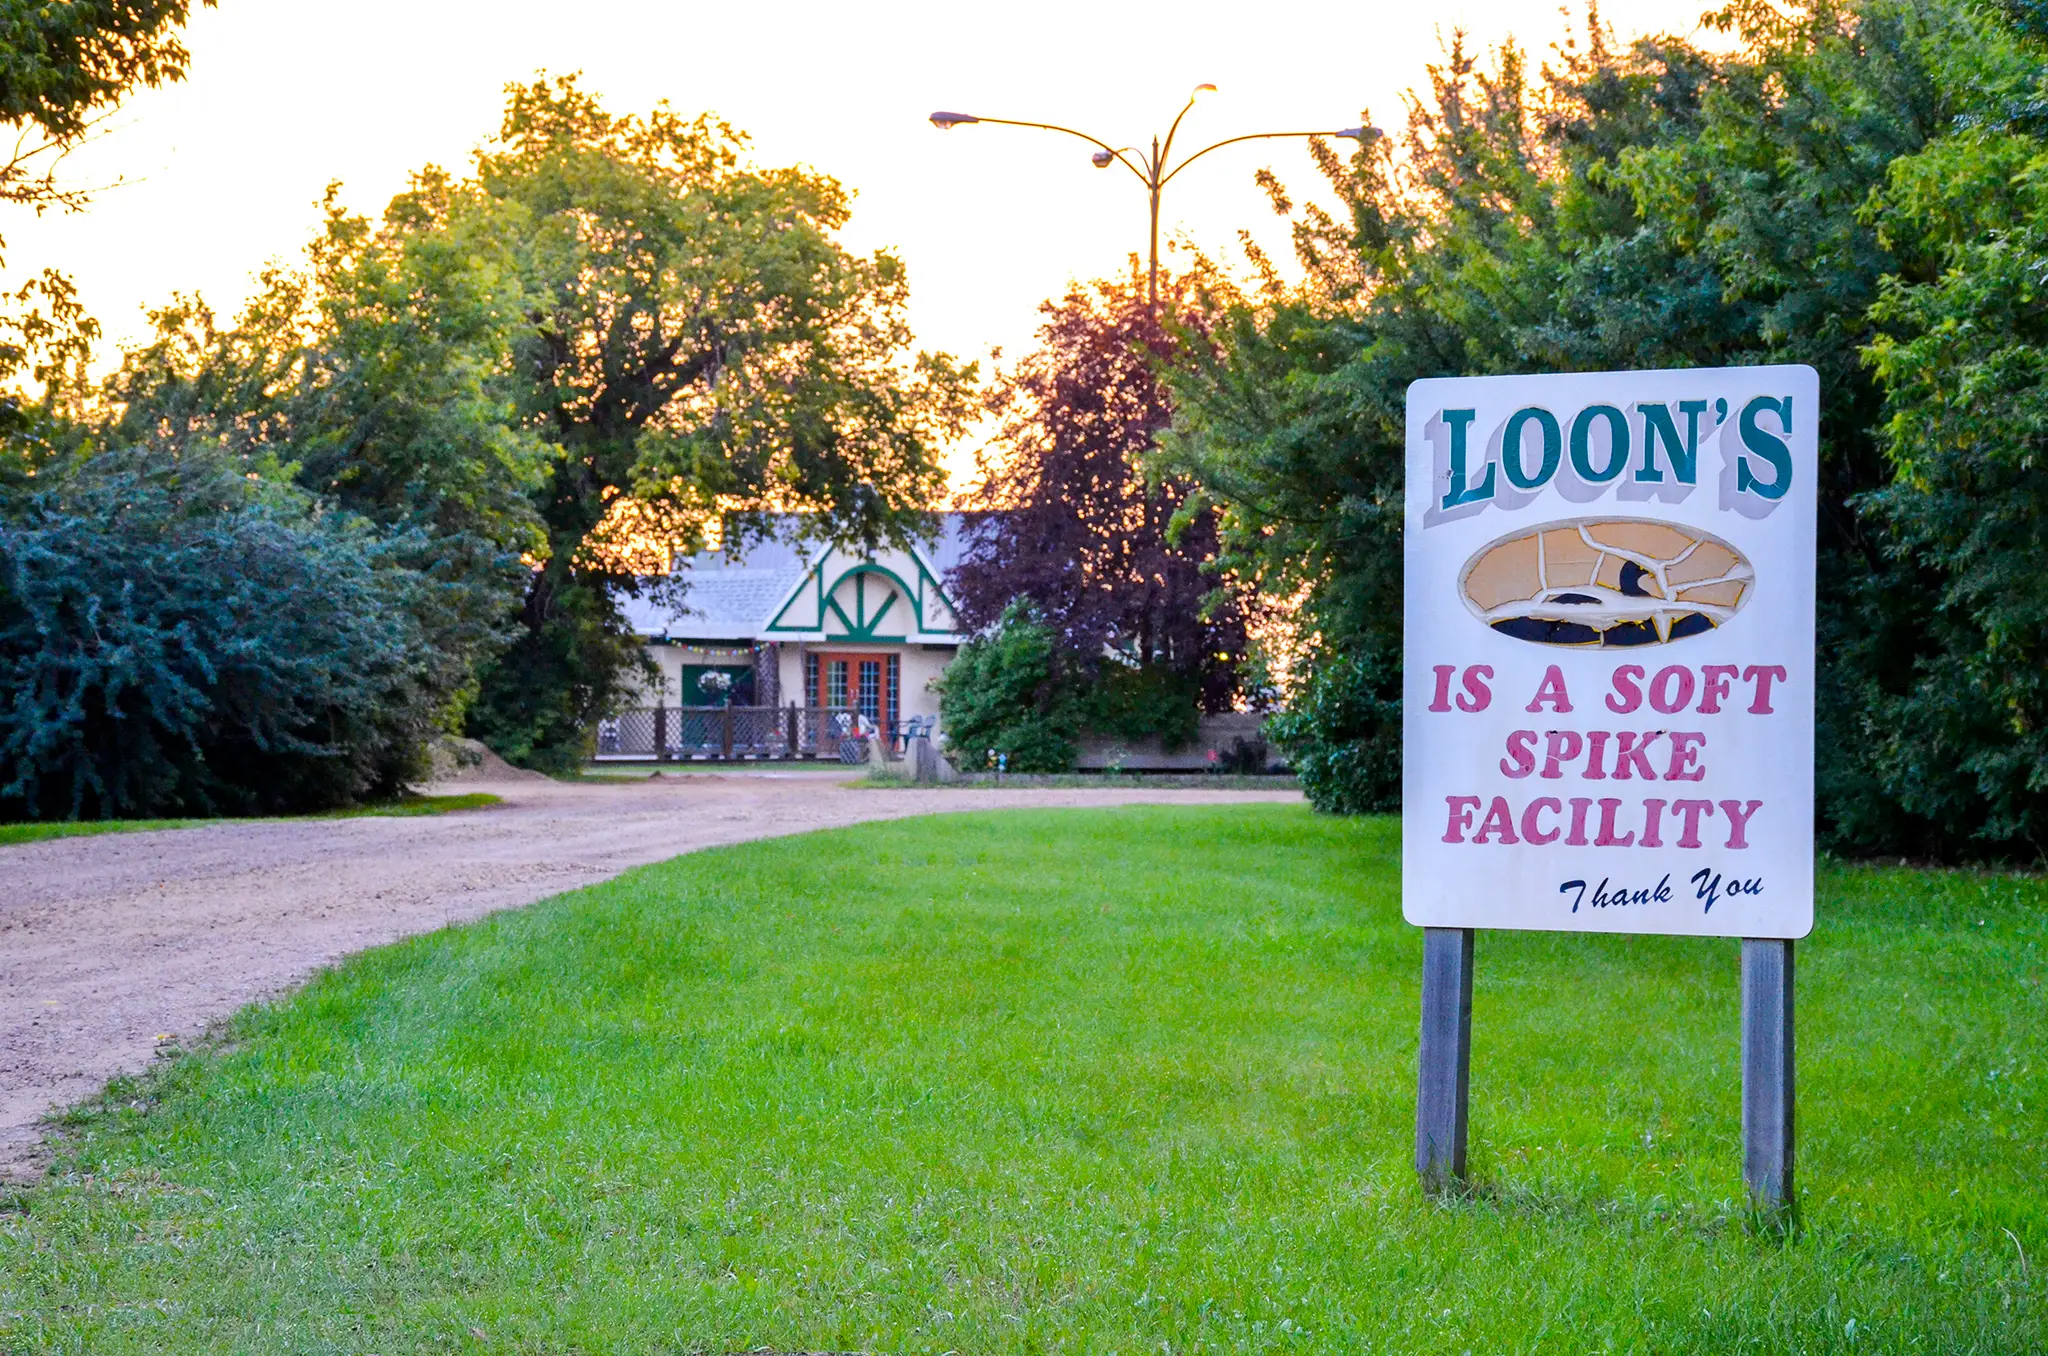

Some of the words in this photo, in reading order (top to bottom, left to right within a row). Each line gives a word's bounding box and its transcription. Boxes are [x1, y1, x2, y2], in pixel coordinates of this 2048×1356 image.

[1441, 395, 1793, 511] LOON'S
[1428, 664, 1494, 714] IS
[1525, 664, 1574, 714] A
[1604, 664, 1787, 716] SOFT
[1499, 729, 1708, 782] SPIKE
[1441, 795, 1764, 850] FACILITY
[1559, 873, 1674, 914] Thank
[1690, 867, 1764, 914] You
